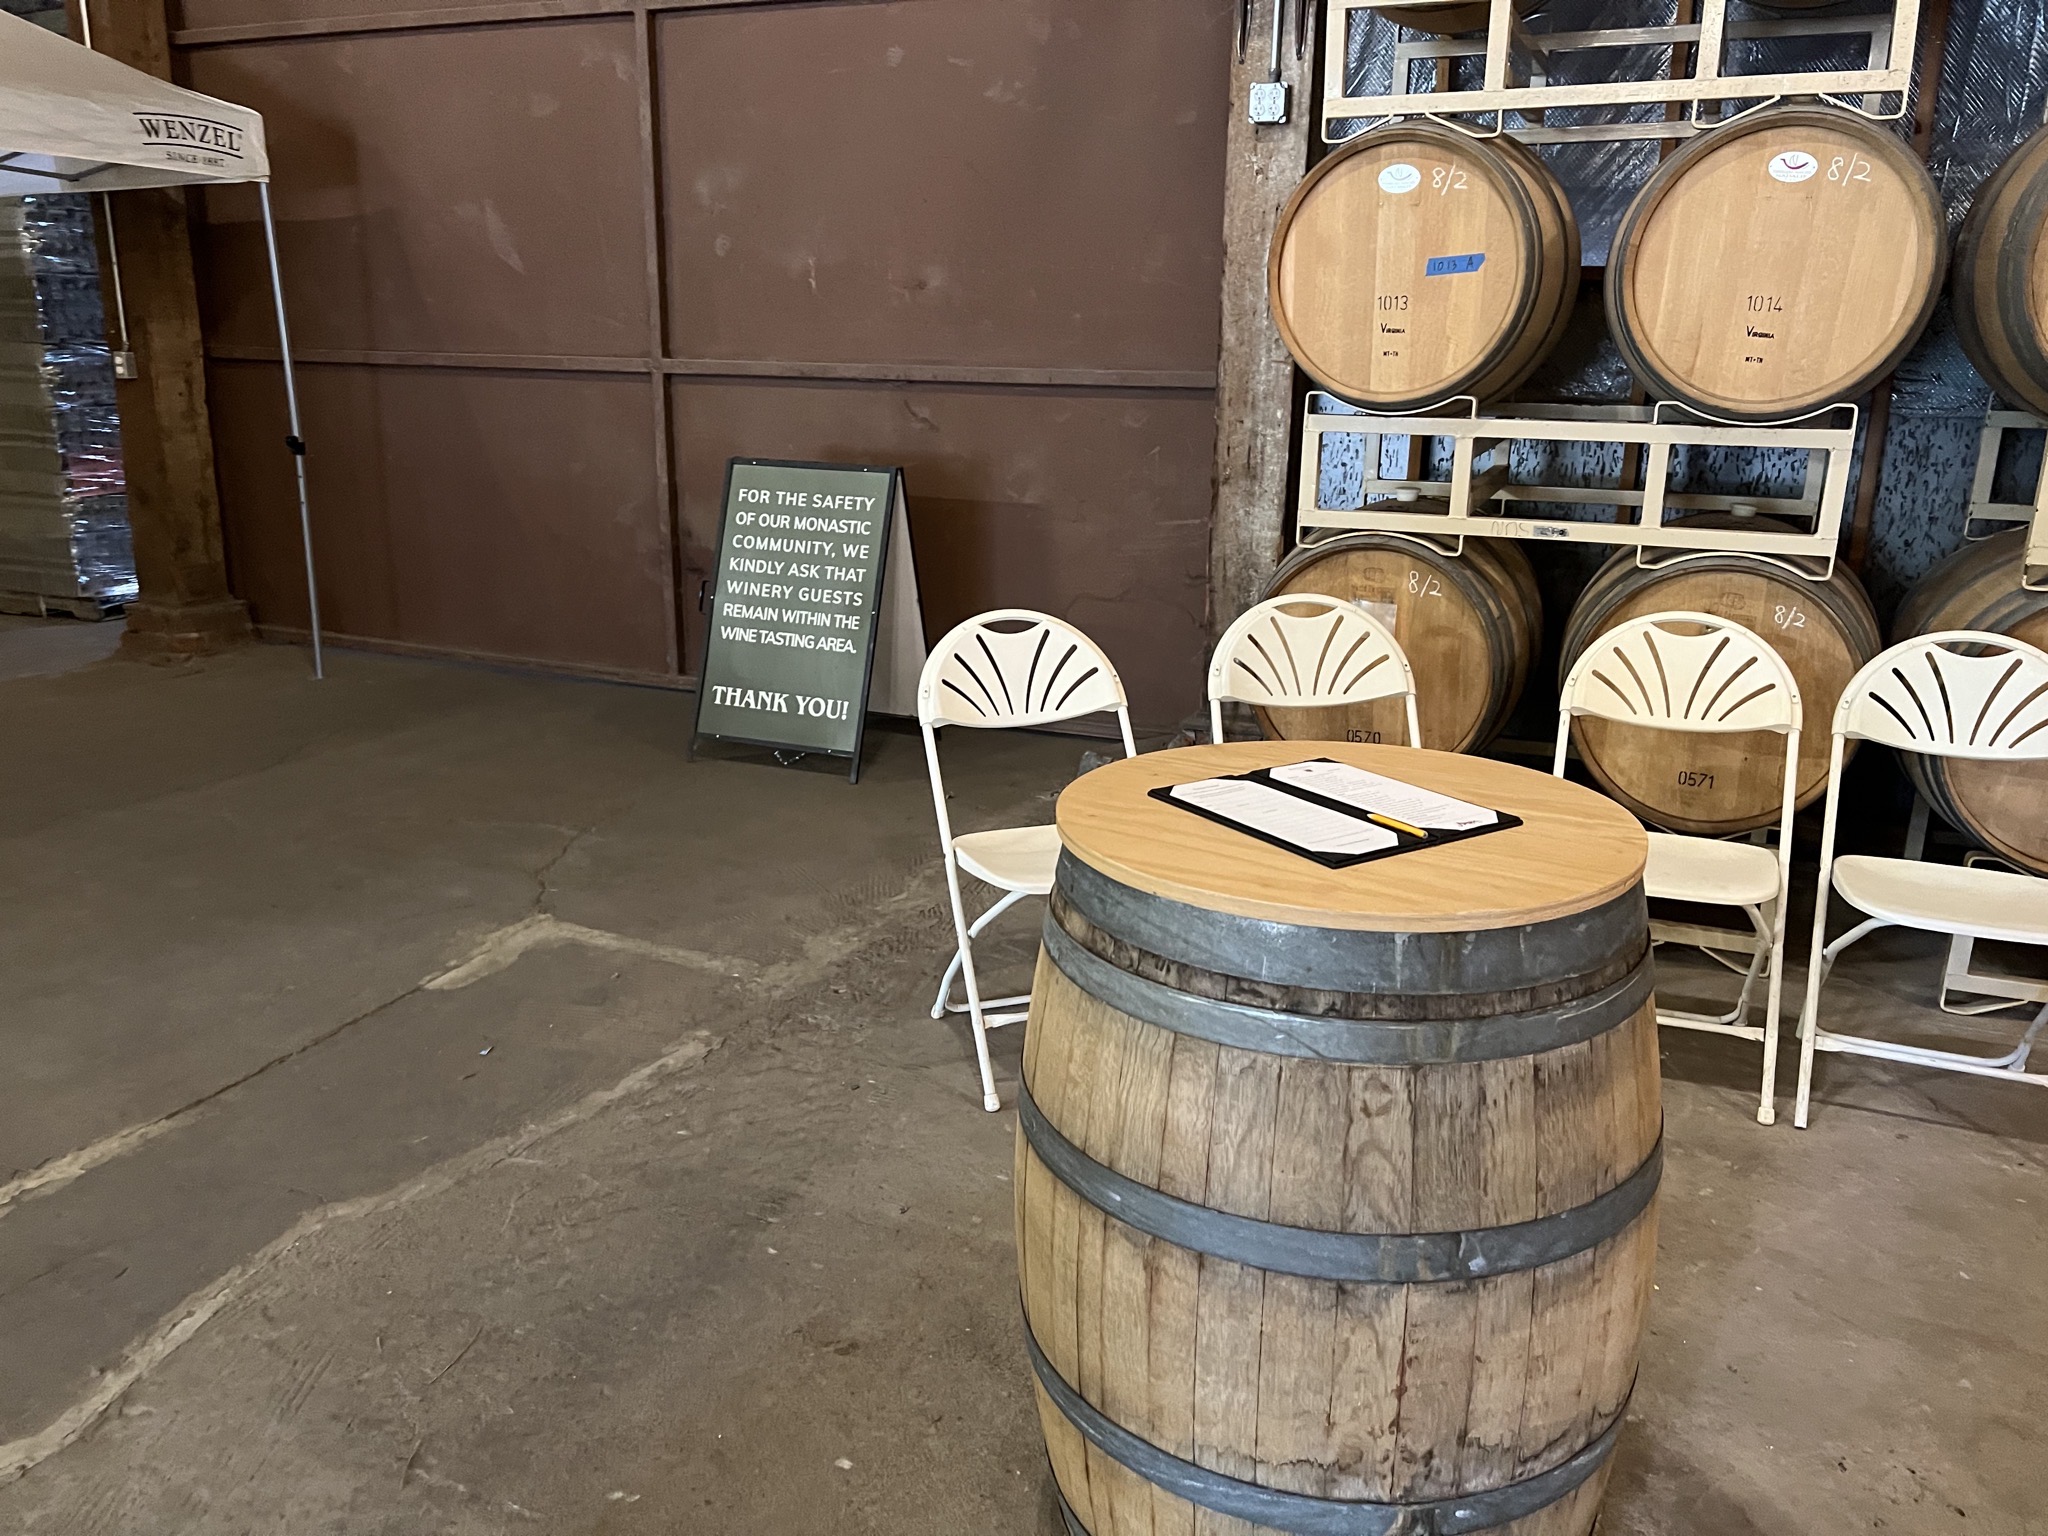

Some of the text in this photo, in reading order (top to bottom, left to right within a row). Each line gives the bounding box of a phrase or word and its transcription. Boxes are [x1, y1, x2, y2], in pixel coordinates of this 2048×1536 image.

[139, 119, 241, 151] WENZEL
[1432, 164, 1468, 196] 8/2
[1828, 152, 1871, 186] 8/2
[1433, 256, 1474, 271] 1013 A
[1378, 295, 1409, 310] 1013
[1748, 296, 1782, 312] 1014
[738, 489, 876, 511] FOR THE SAFETY
[735, 512, 871, 535] OF OUR MONASTIC
[732, 534, 869, 559] COMMUNITY, WE
[729, 557, 866, 583] KINDLY ASK THAT
[727, 580, 863, 606] WINERY GUESTS
[1409, 571, 1442, 597] 8/2
[723, 603, 860, 630] REMAIN WITHIN THE
[1775, 606, 1805, 629] 8/2
[721, 626, 856, 654] WINE TASTING AREA.
[712, 685, 849, 720] THANK YOU!
[1347, 730, 1380, 744] 0570
[1678, 771, 1714, 789] 0571
